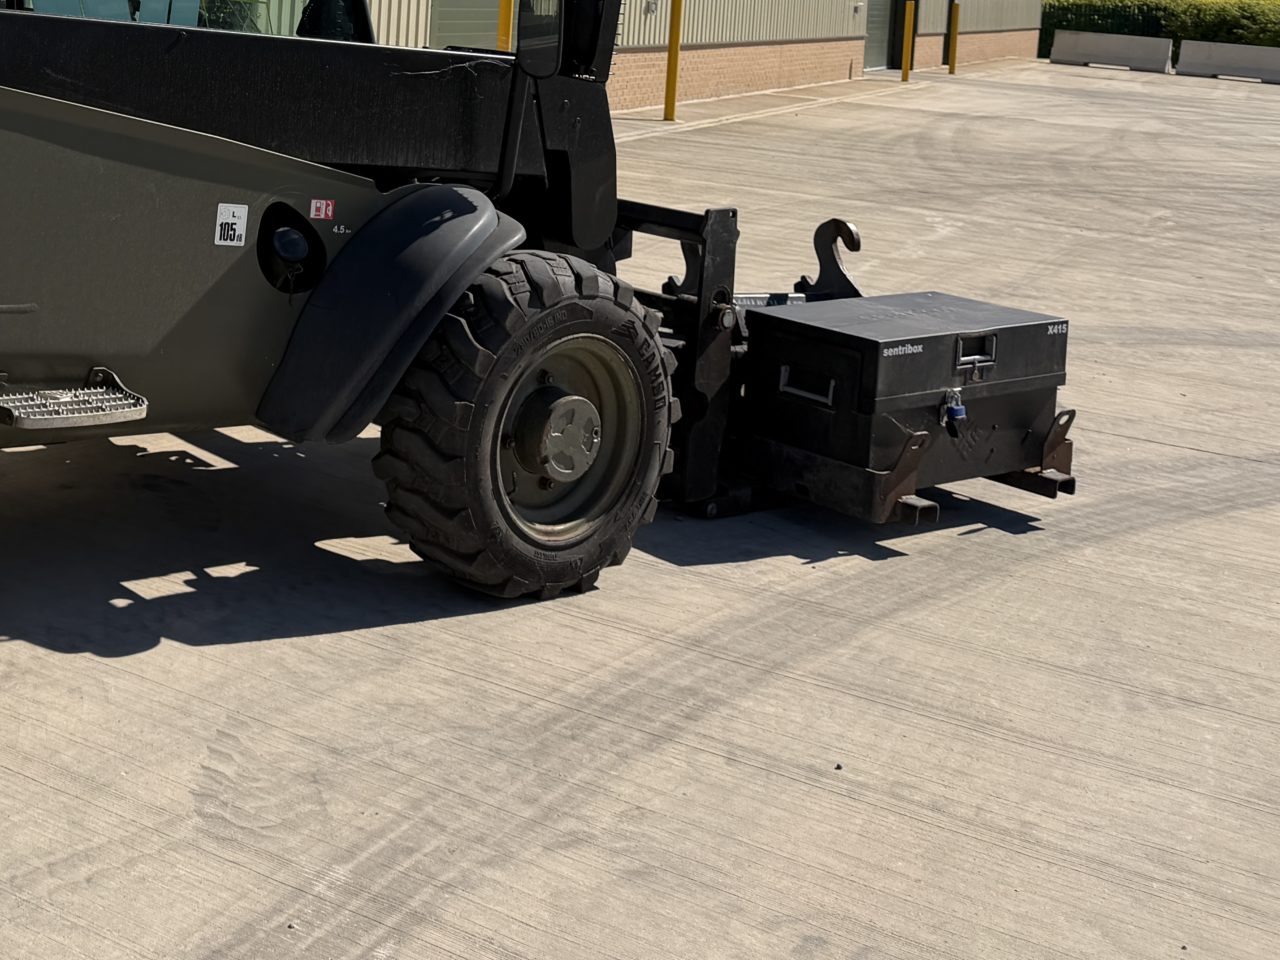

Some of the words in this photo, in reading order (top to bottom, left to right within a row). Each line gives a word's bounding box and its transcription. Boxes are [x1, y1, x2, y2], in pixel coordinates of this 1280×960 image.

[219, 221, 237, 242] 105
[332, 225, 345, 234] 4.5
[1047, 323, 1068, 336] X415
[883, 343, 923, 357] sentribox
